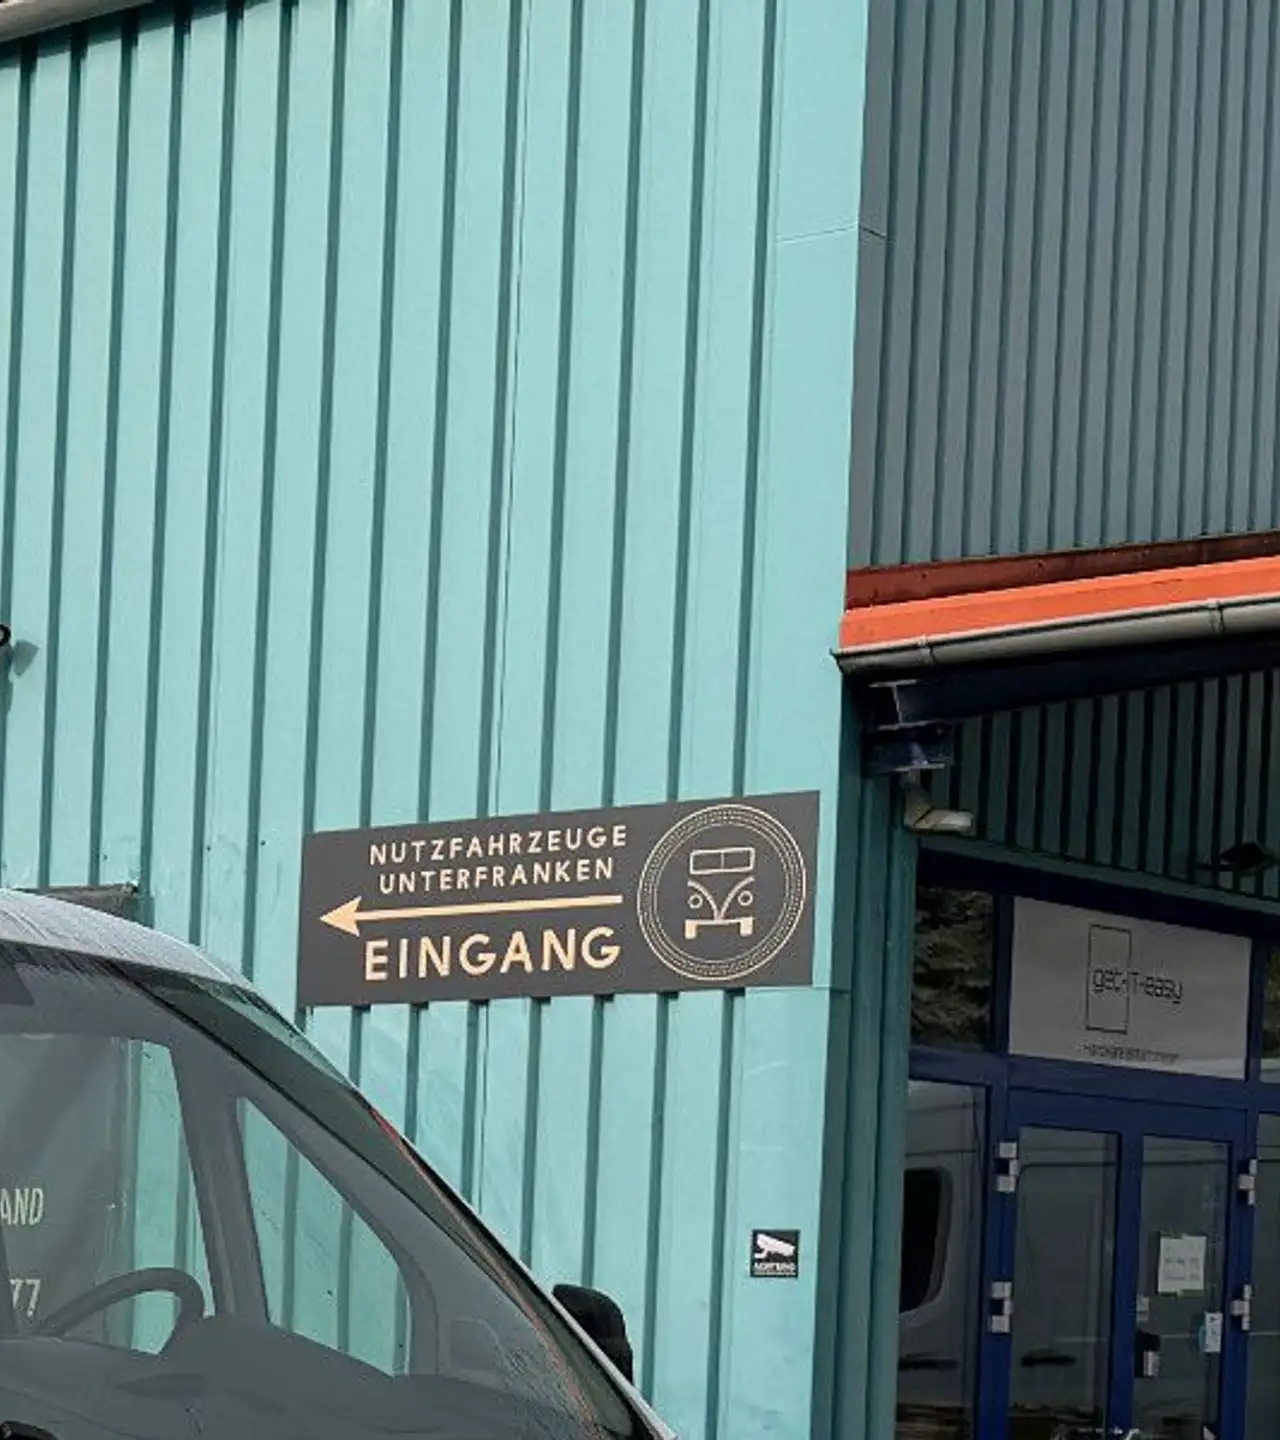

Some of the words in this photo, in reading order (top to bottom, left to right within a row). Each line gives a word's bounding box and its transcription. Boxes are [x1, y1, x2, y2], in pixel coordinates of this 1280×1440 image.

[369, 824, 628, 866] NUTZFAHRZEUGE
[378, 856, 615, 895] UNTERFRANKEN
[364, 926, 622, 981] EINGANG
[0, 1187, 44, 1226] AND
